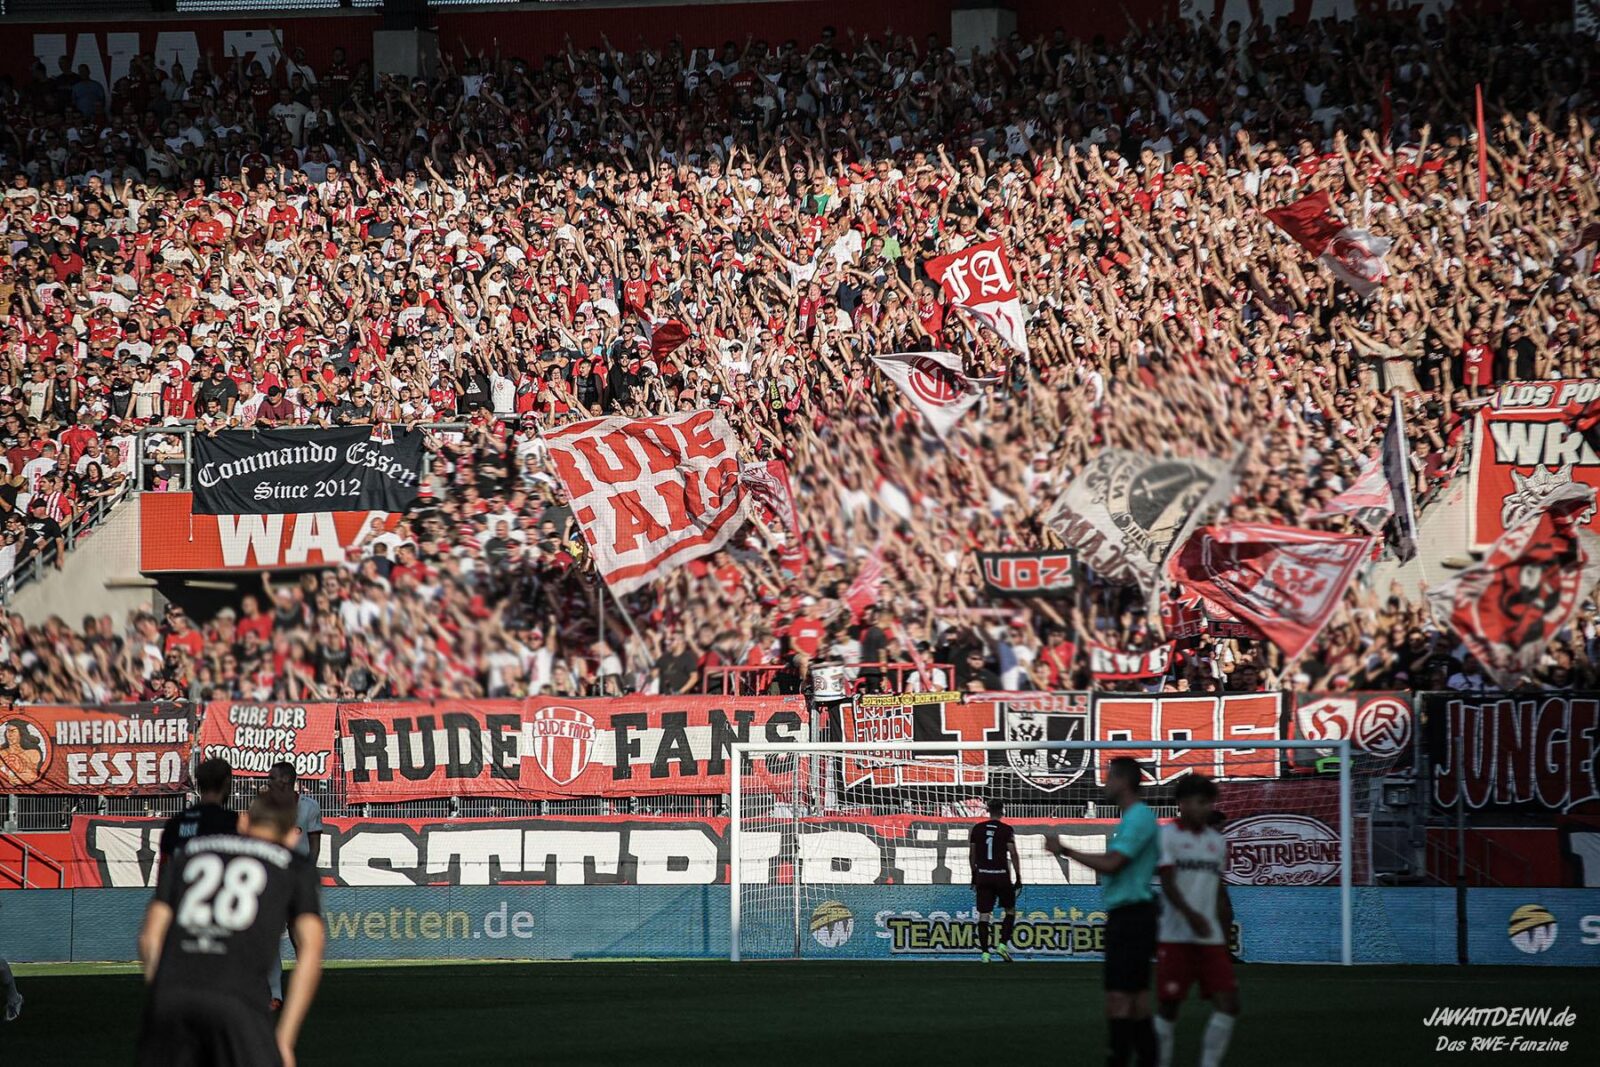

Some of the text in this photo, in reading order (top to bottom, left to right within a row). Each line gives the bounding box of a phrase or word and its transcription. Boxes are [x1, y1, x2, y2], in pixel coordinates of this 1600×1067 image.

[1503, 384, 1554, 406] LOS
[197, 440, 418, 489] Commando Essen
[253, 478, 361, 500] Since 2012
[56, 714, 189, 746] HAFENSÄNGER
[229, 704, 306, 729] EHRE DER
[234, 726, 296, 752] GRUPPE
[349, 709, 802, 782] RUDE FANS
[66, 751, 183, 787] ESSEN
[985, 836, 994, 860] 1
[177, 852, 268, 932] 28
